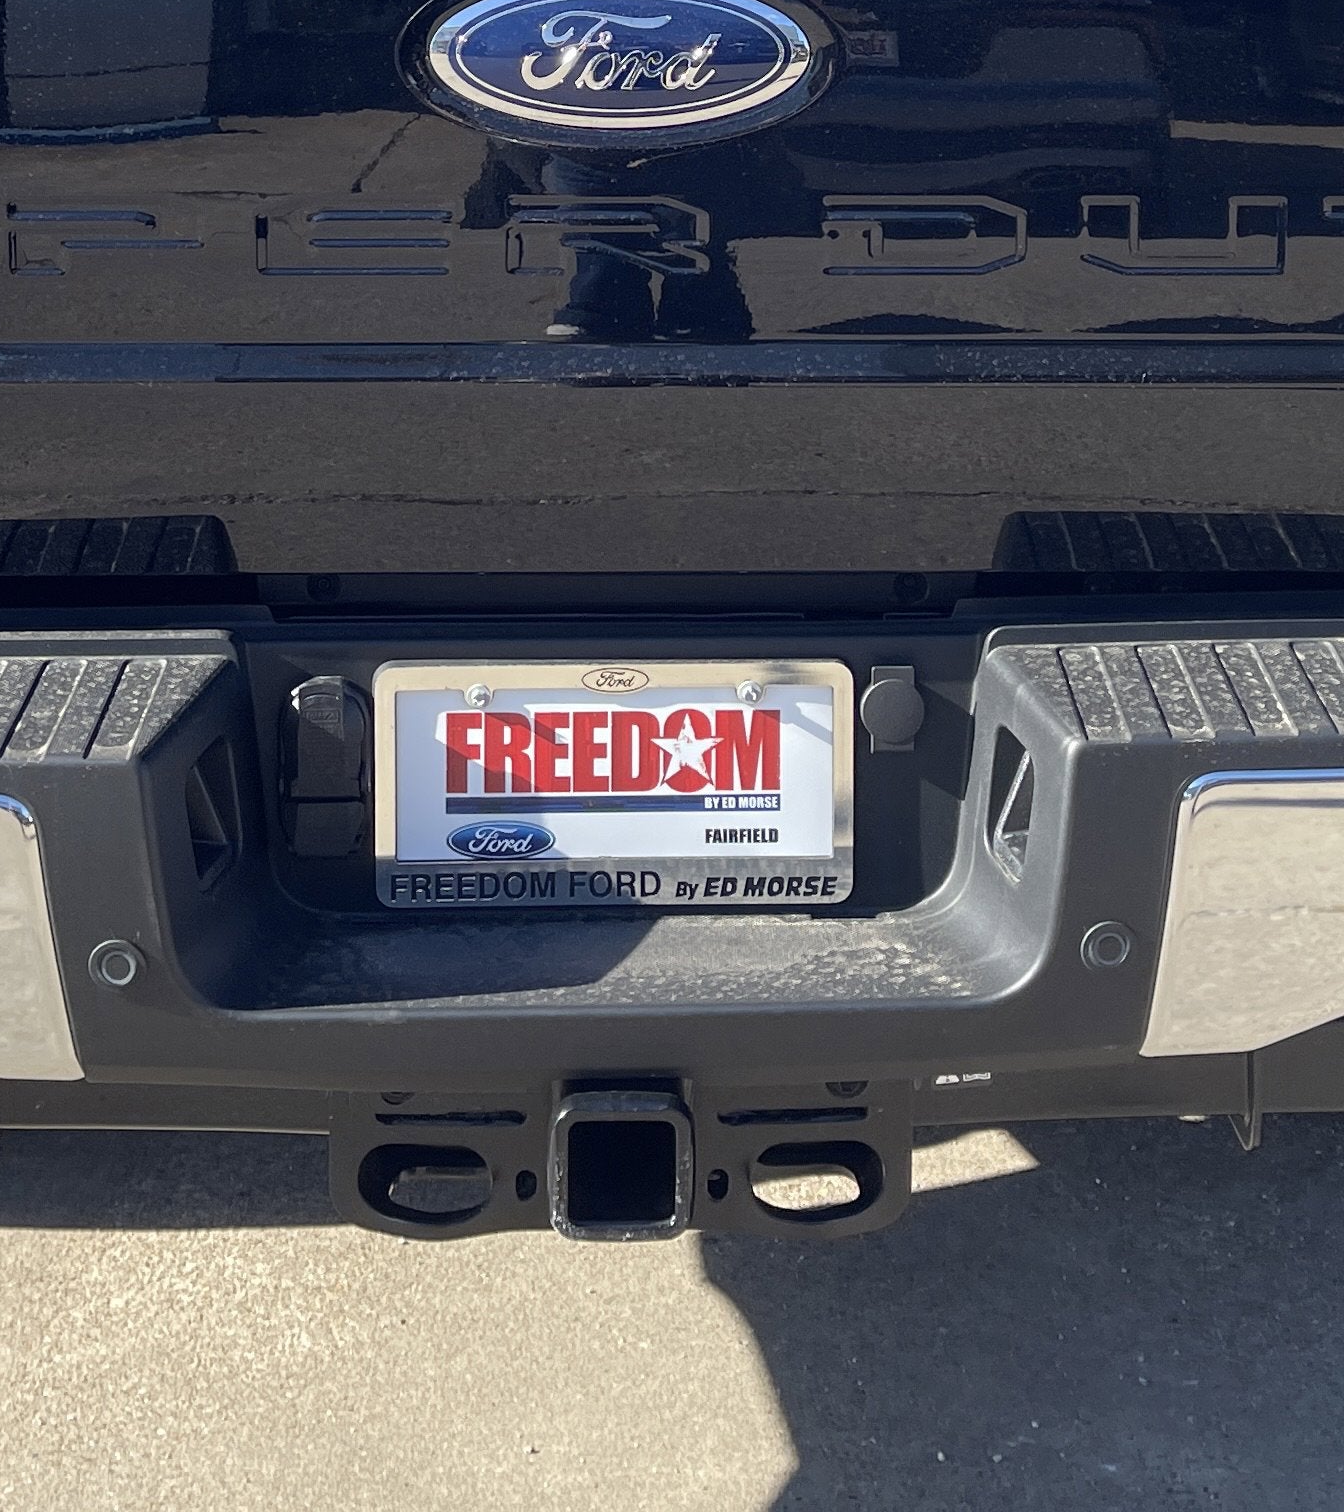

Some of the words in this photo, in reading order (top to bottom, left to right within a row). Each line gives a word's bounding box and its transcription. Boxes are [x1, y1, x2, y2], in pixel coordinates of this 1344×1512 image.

[522, 10, 723, 91] Ford
[595, 670, 635, 688] Ford
[446, 709, 781, 793] FREEDOM
[704, 796, 719, 809] BY
[722, 796, 736, 809] ED
[738, 796, 779, 809] MORSE
[468, 826, 534, 853] Ford
[705, 828, 779, 843] FAIRFIELD
[390, 871, 556, 903] FREEDOM
[569, 870, 662, 899] FORD
[675, 881, 699, 901] By
[703, 876, 738, 898] ED
[743, 876, 838, 898] MORSE
